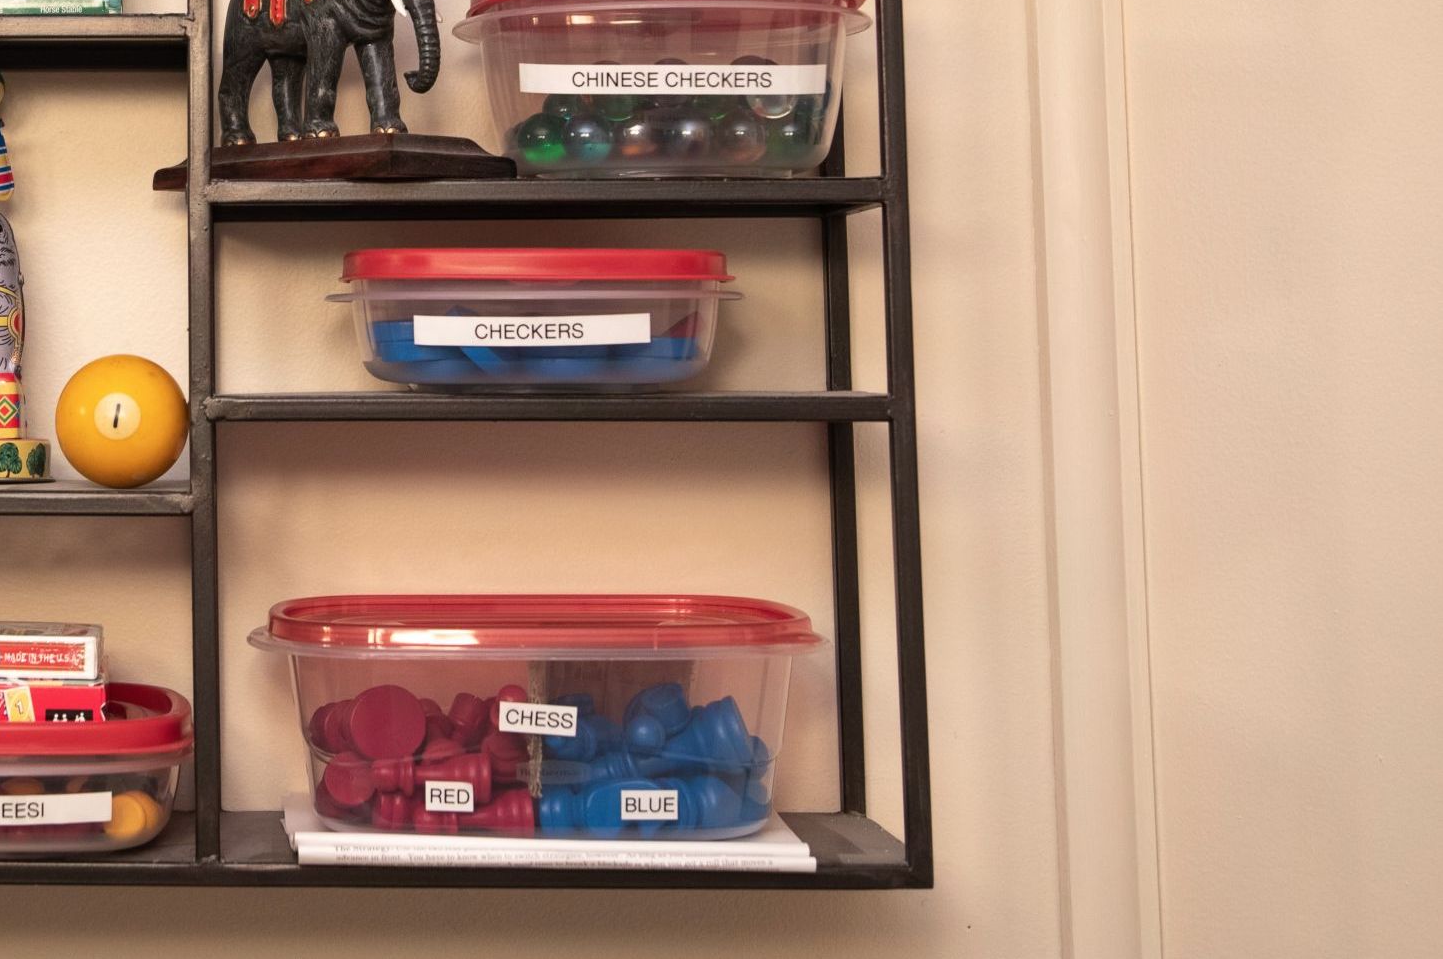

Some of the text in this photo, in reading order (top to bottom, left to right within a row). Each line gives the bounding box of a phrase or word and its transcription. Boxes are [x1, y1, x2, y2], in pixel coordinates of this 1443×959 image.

[571, 70, 773, 89] CHINESE CHECKERS
[474, 322, 584, 341] CHECKERS
[112, 403, 121, 429] 1
[4, 652, 28, 663] MADE
[504, 707, 574, 731] CHESS
[429, 787, 471, 806] RED
[623, 796, 676, 815] BLUE
